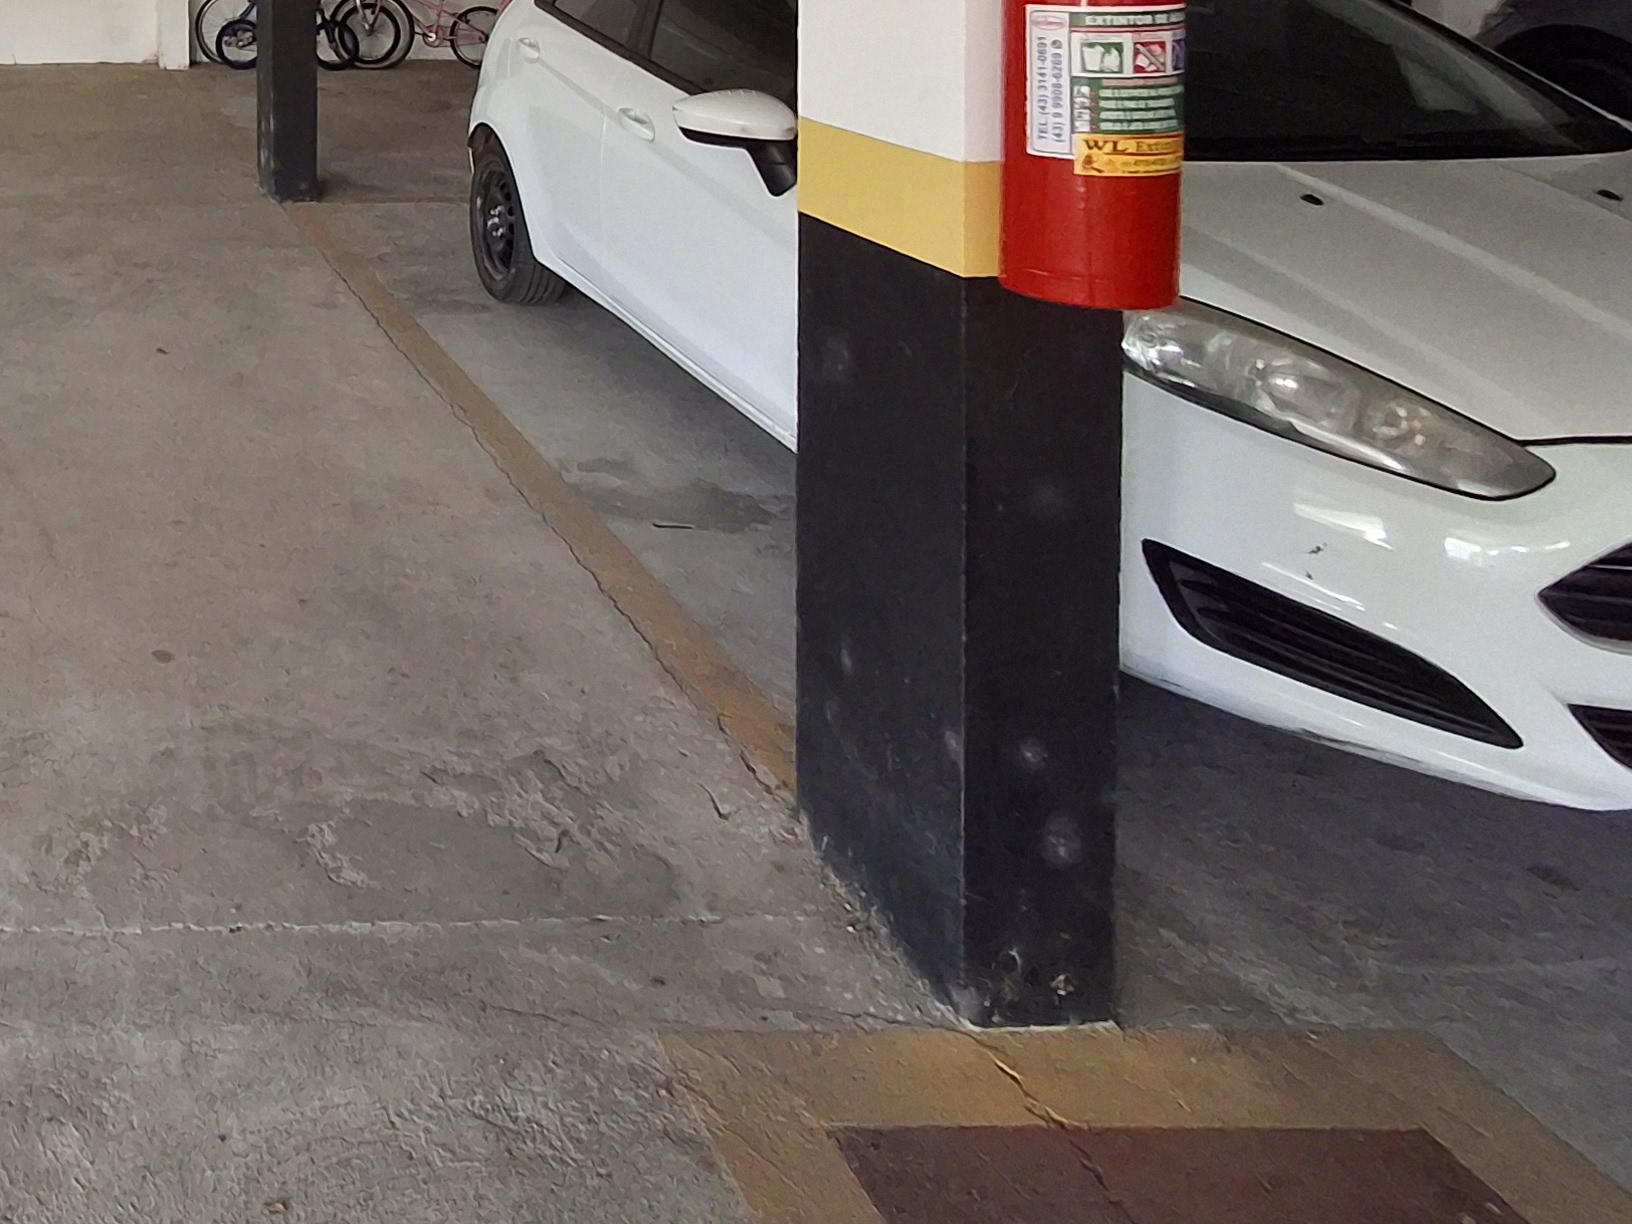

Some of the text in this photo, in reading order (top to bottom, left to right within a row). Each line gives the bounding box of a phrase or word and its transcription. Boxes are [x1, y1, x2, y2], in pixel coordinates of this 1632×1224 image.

[1037, 94, 1049, 116] (43)
[1037, 120, 1048, 140] TEL
[1082, 139, 1129, 153] WL
